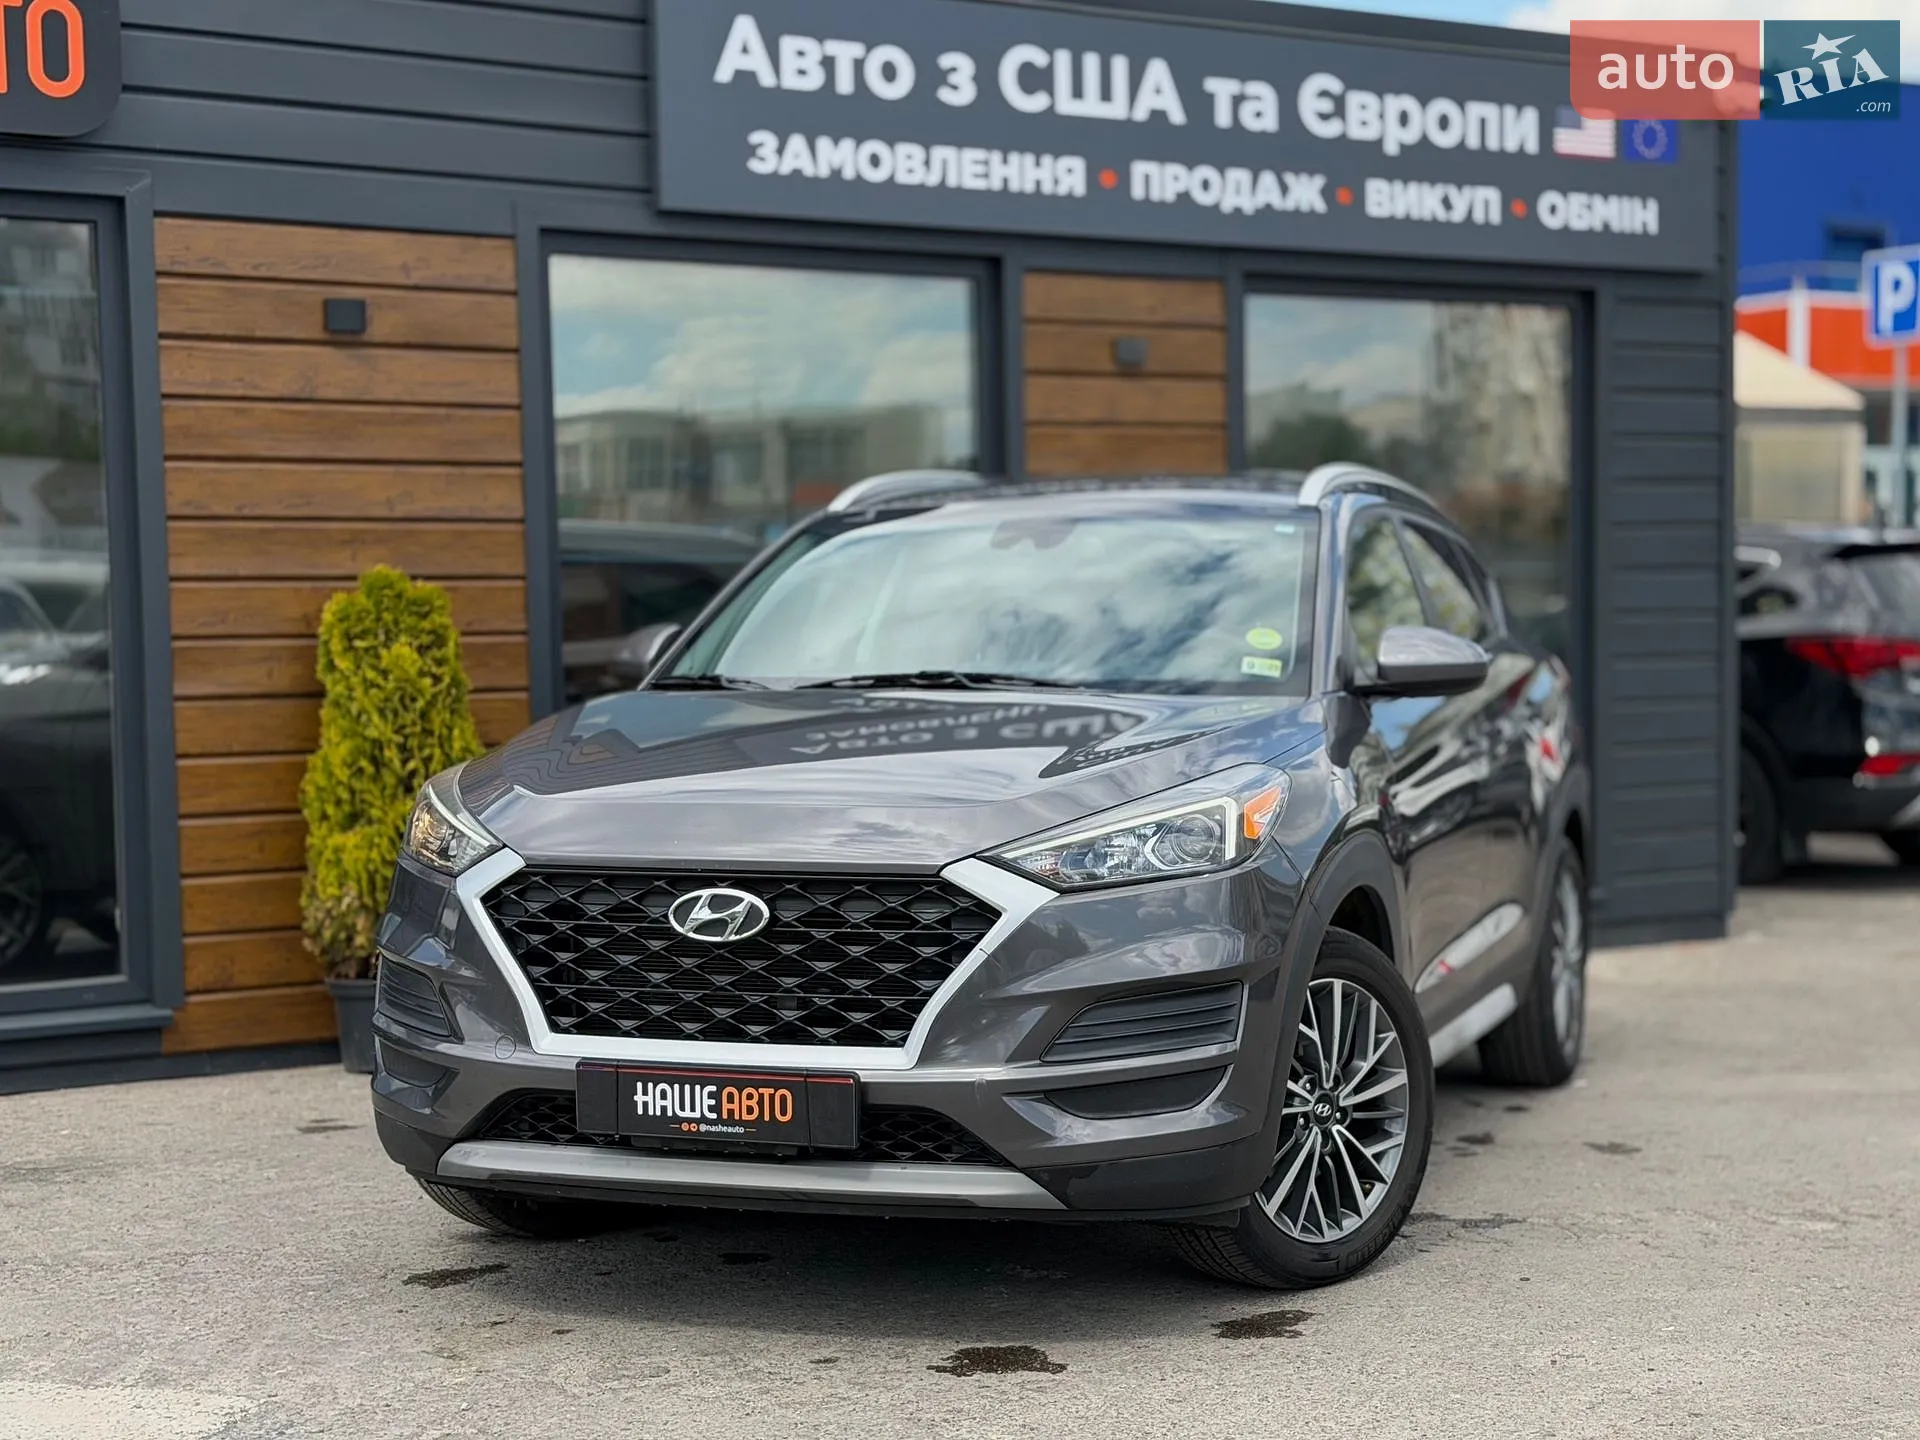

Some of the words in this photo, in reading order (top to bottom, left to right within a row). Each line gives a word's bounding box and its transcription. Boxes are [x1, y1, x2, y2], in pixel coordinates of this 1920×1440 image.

[713, 14, 915, 100] Авто
[936, 51, 978, 107] з
[999, 43, 1188, 126] США
[1203, 76, 1280, 133] та
[1297, 72, 1540, 156] Європи
[746, 129, 1086, 198] ЗАМОВЛЕННЯ
[1130, 160, 1328, 215] ПРОДАЖ
[1364, 177, 1502, 226] ВИКУП
[1536, 190, 1659, 236] ОБМІН
[1879, 261, 1916, 336] P
[633, 1081, 718, 1120] НАШЕ
[721, 1086, 793, 1122] АВТО
[699, 1123, 744, 1134] @nasheauto
